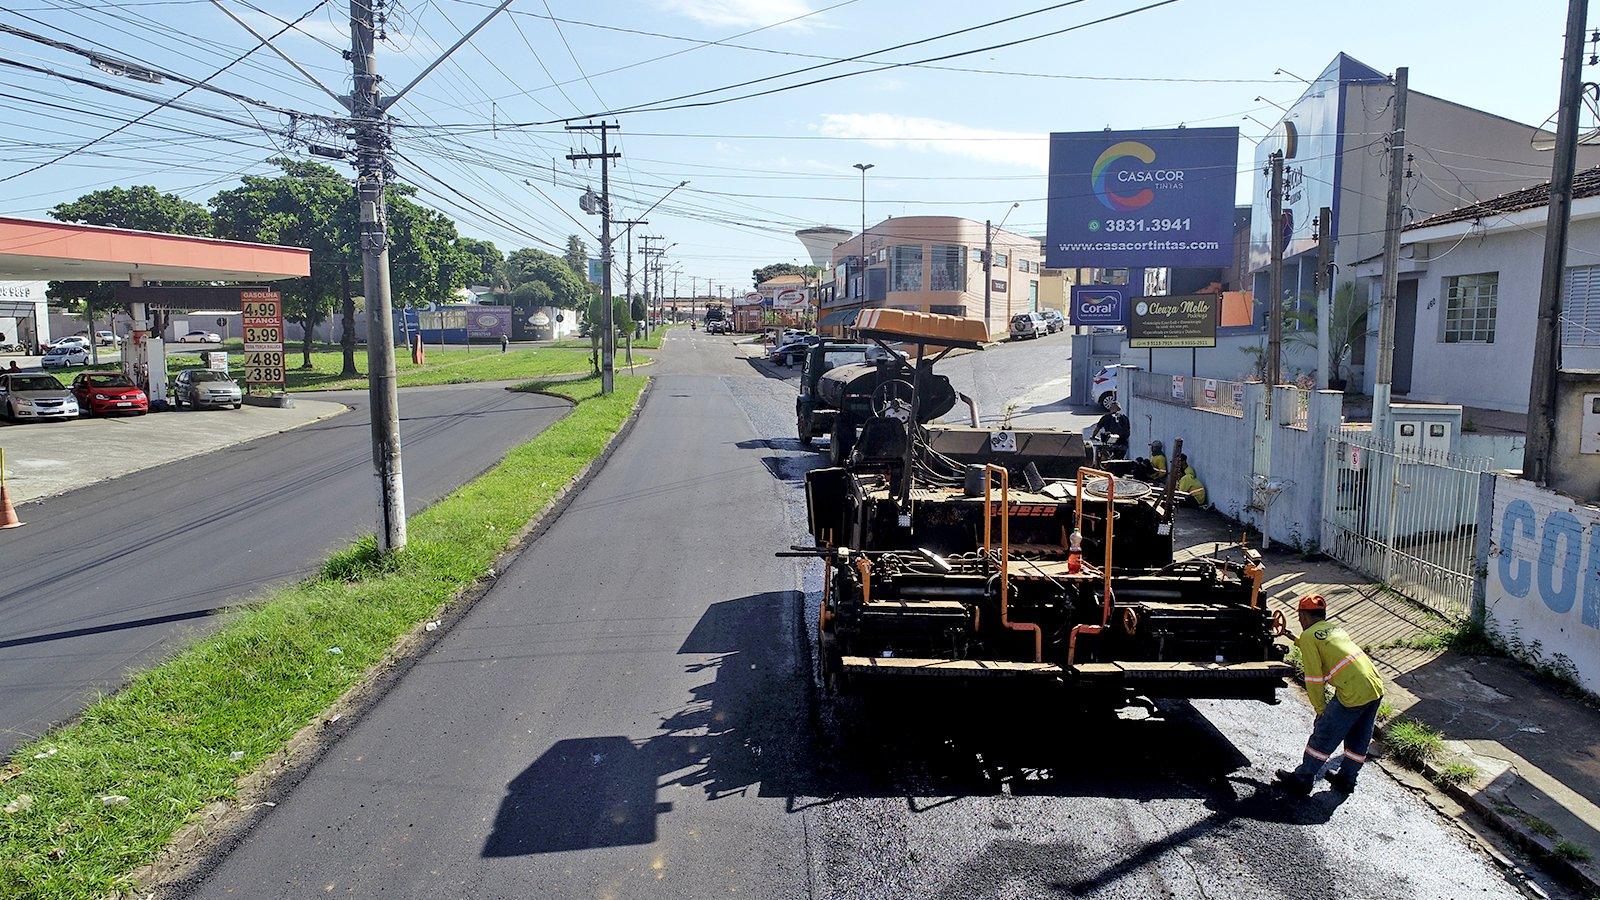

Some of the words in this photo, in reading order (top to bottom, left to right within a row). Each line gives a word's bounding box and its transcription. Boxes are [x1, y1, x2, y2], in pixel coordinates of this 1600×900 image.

[1118, 170, 1153, 182] CASA
[1155, 170, 1184, 181] COR
[1105, 218, 1191, 232] 3831.3941
[1059, 240, 1219, 251] www.casacortintas.com
[245, 303, 276, 316] 4,99
[1081, 303, 1111, 313] Coral
[1149, 302, 1179, 317] Cleuza
[1180, 300, 1210, 313] Mello
[247, 328, 278, 342] 3,99
